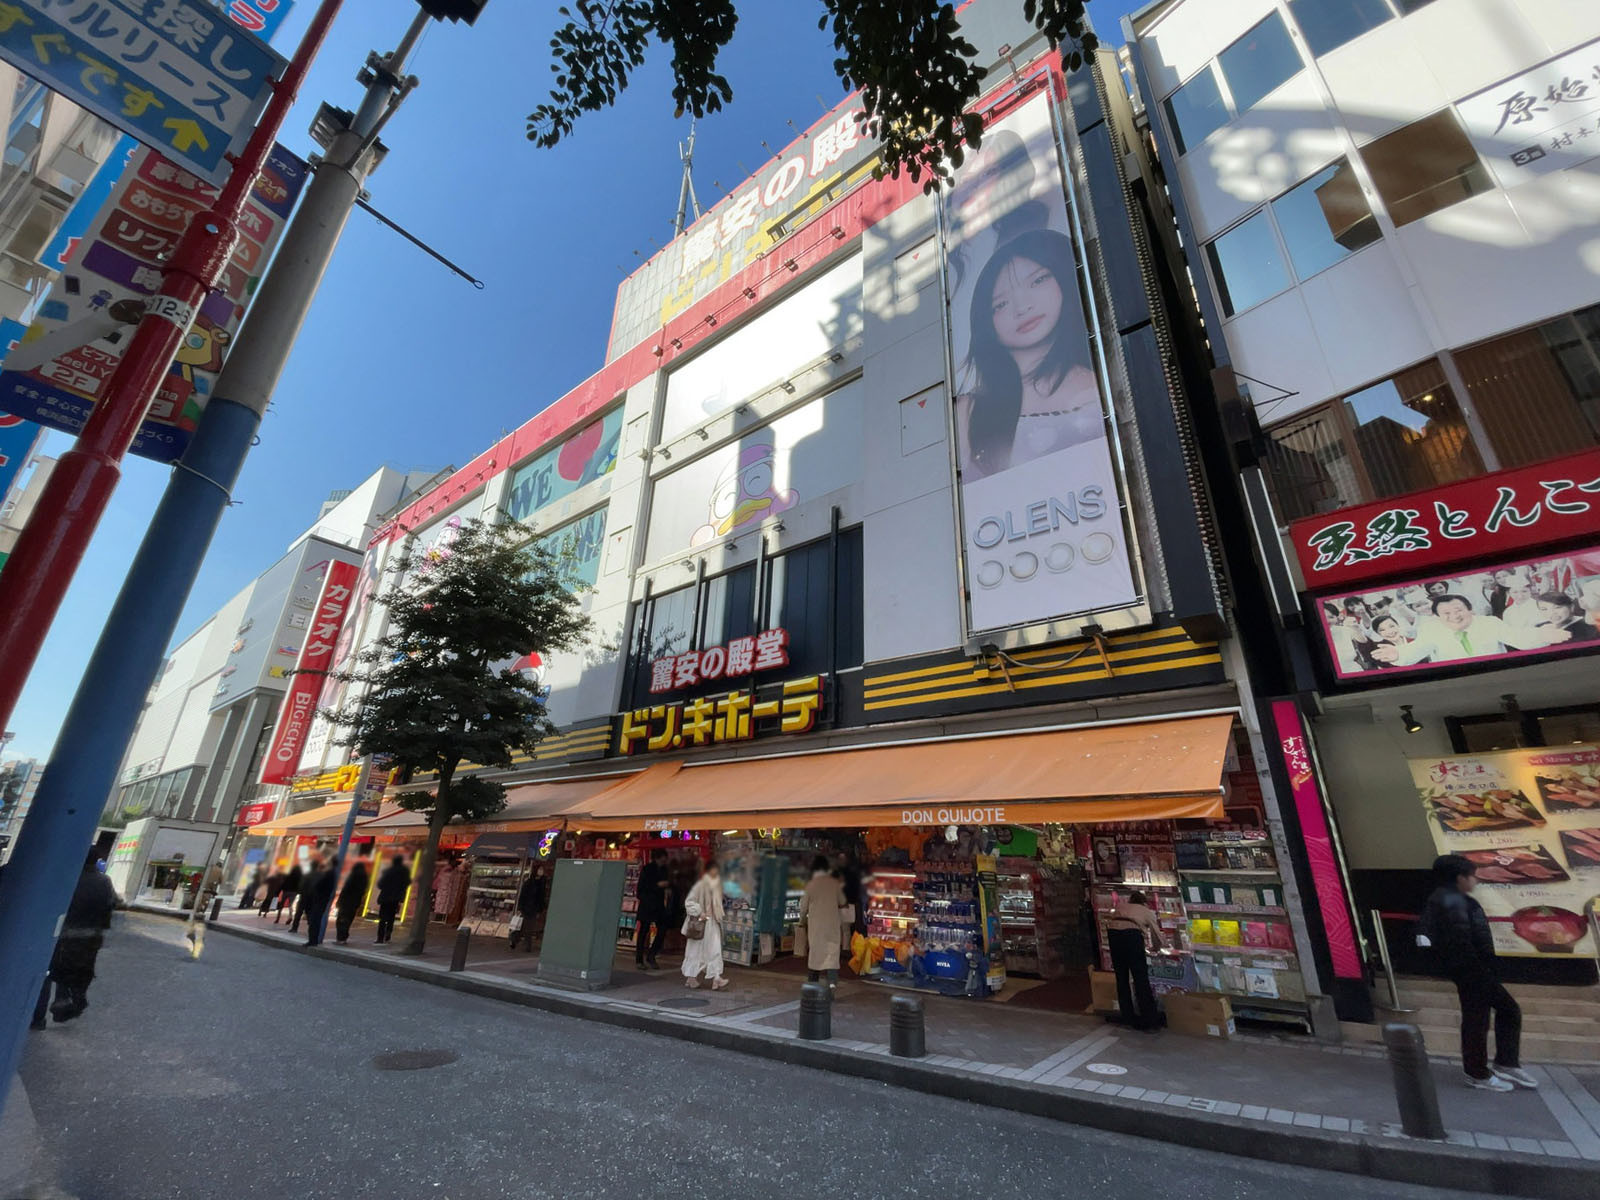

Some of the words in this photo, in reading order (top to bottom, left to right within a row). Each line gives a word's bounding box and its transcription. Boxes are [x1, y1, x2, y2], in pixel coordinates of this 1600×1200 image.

[0, 3, 165, 117] すぐです
[38, 0, 231, 122] ルリース
[681, 98, 882, 278] 驚安の殿
[51, 366, 89, 388] 2F
[58, 356, 98, 373] eeU
[507, 463, 553, 522] WE
[973, 484, 1107, 548] OLENS
[307, 584, 351, 657] カラオケ
[650, 627, 790, 694] 驚安の殿堂
[293, 691, 312, 721] BIG
[277, 721, 303, 762] ECHO
[902, 810, 933, 824] DON
[937, 807, 1007, 824] QUIJOTE
